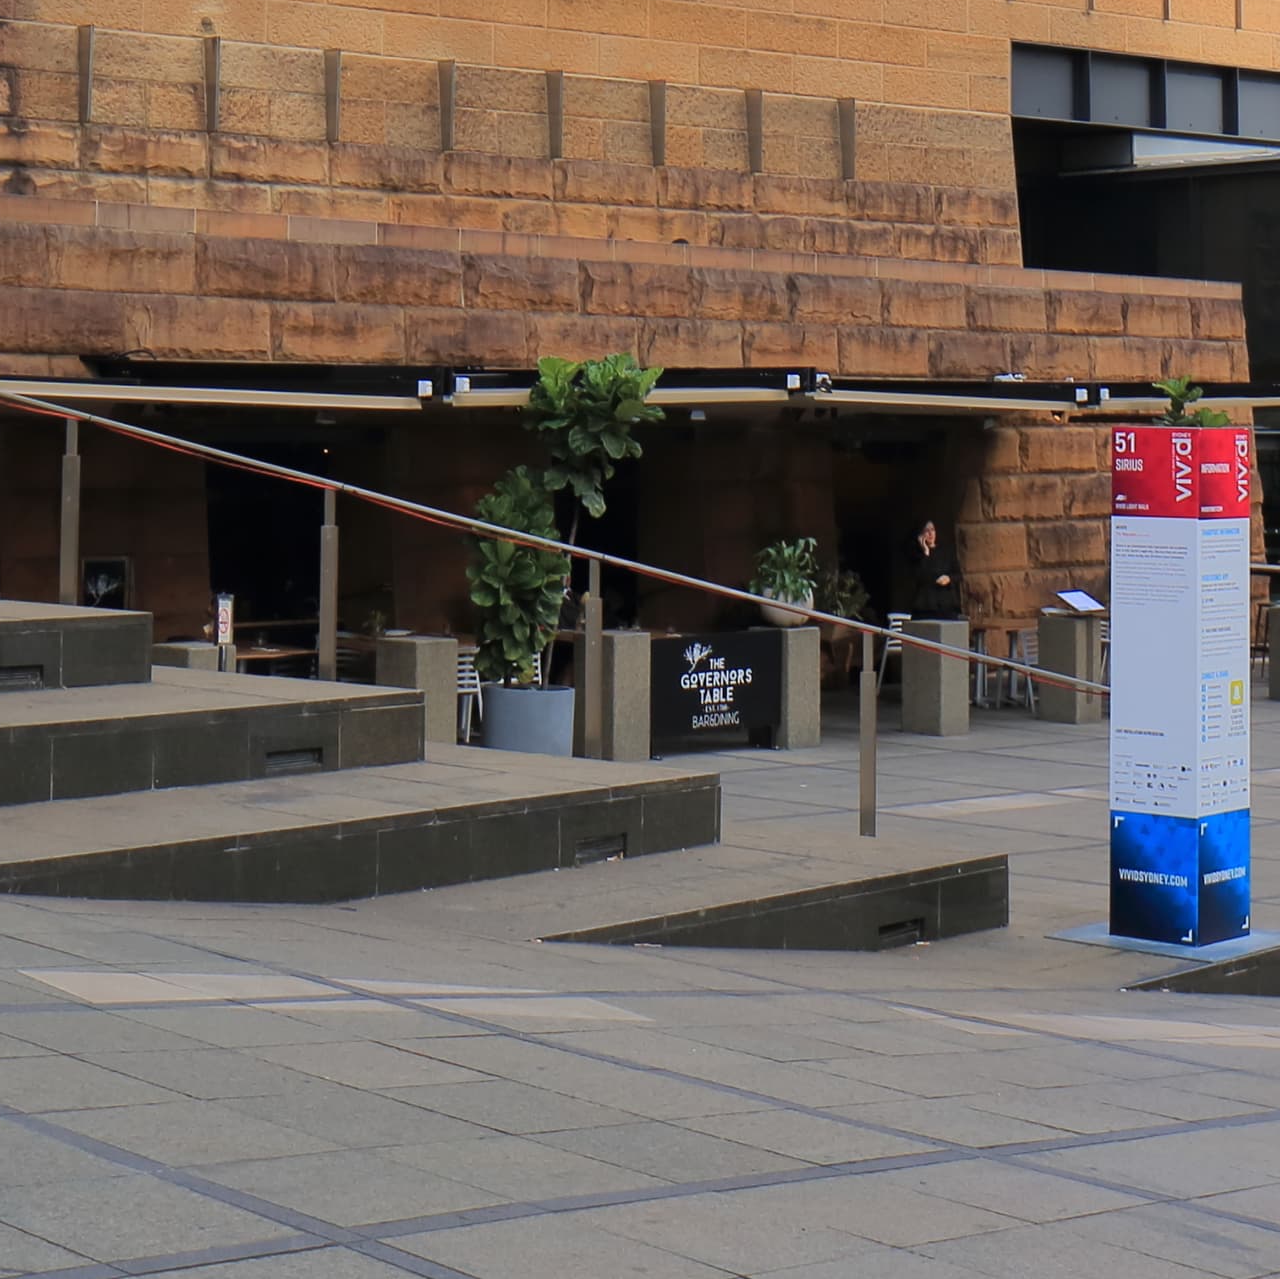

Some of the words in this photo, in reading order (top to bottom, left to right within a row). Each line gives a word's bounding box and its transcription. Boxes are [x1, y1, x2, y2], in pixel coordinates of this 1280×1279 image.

[1115, 431, 1136, 454] 51
[1115, 458, 1144, 472] SIRIUS
[709, 657, 726, 670] THE
[680, 667, 753, 689] GOVERNORS
[699, 686, 734, 705] TABLE
[1118, 866, 1188, 888] VIVIDSYDNEY.COM
